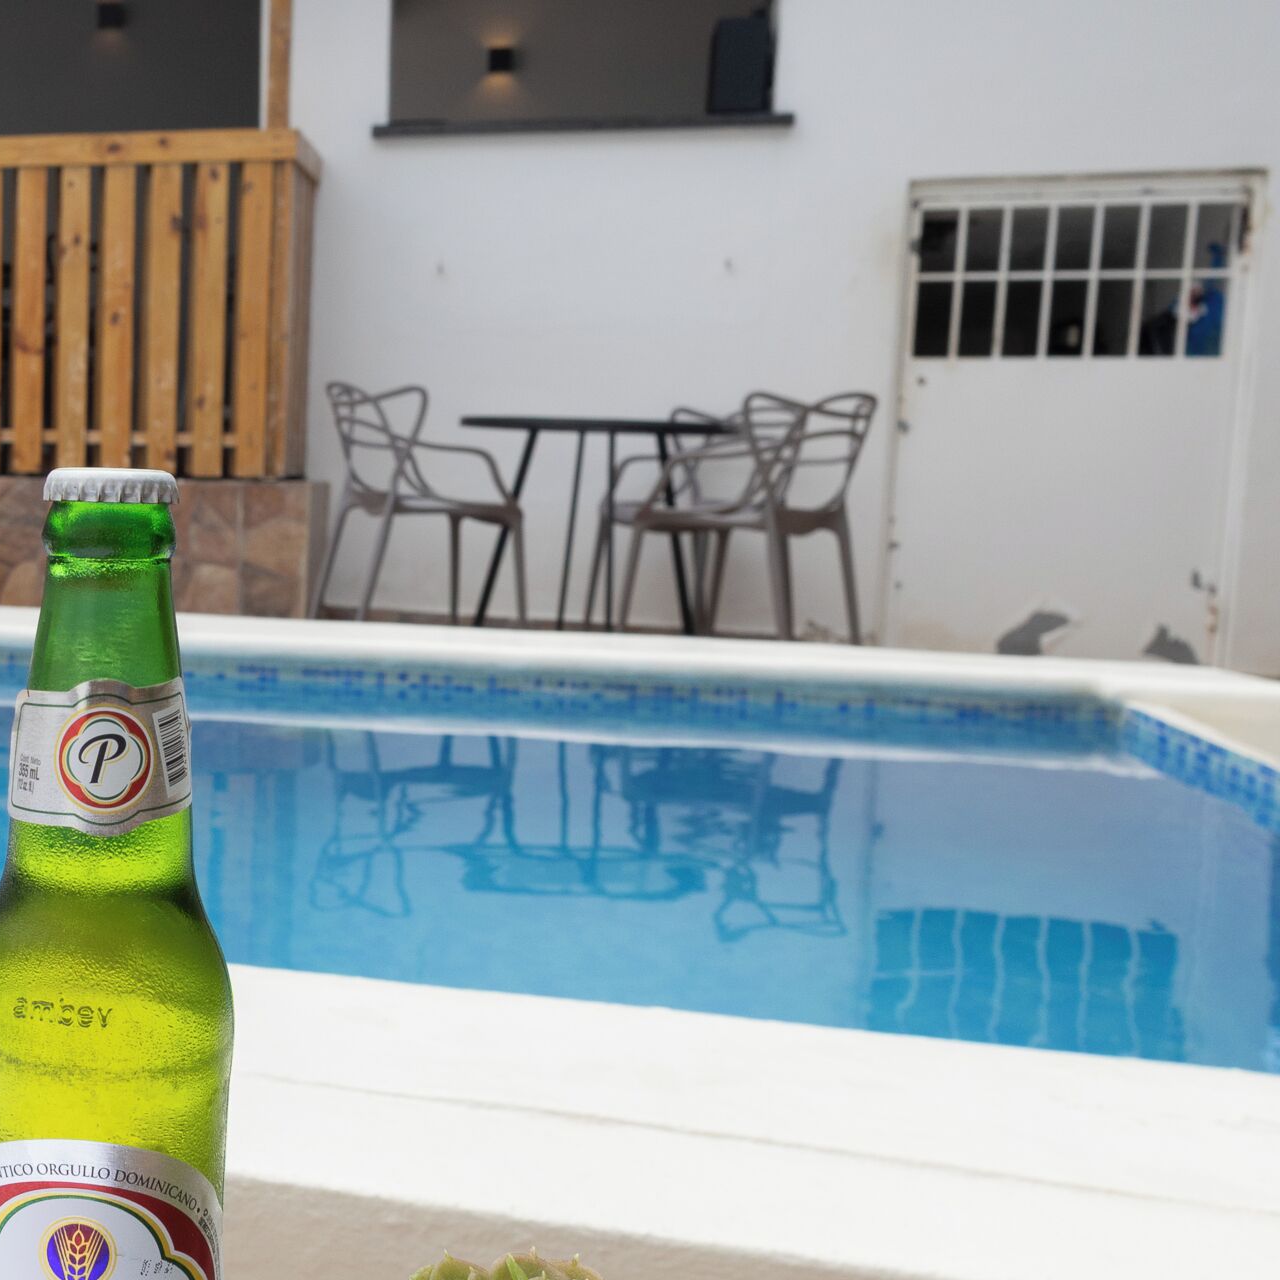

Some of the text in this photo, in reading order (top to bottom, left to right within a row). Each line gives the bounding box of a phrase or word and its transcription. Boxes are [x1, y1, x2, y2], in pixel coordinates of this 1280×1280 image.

[18, 762, 40, 781] 355 mL
[78, 733, 127, 784] P
[36, 1163, 110, 1180] ORGULLO
[114, 1169, 198, 1211] DOMINICANO
